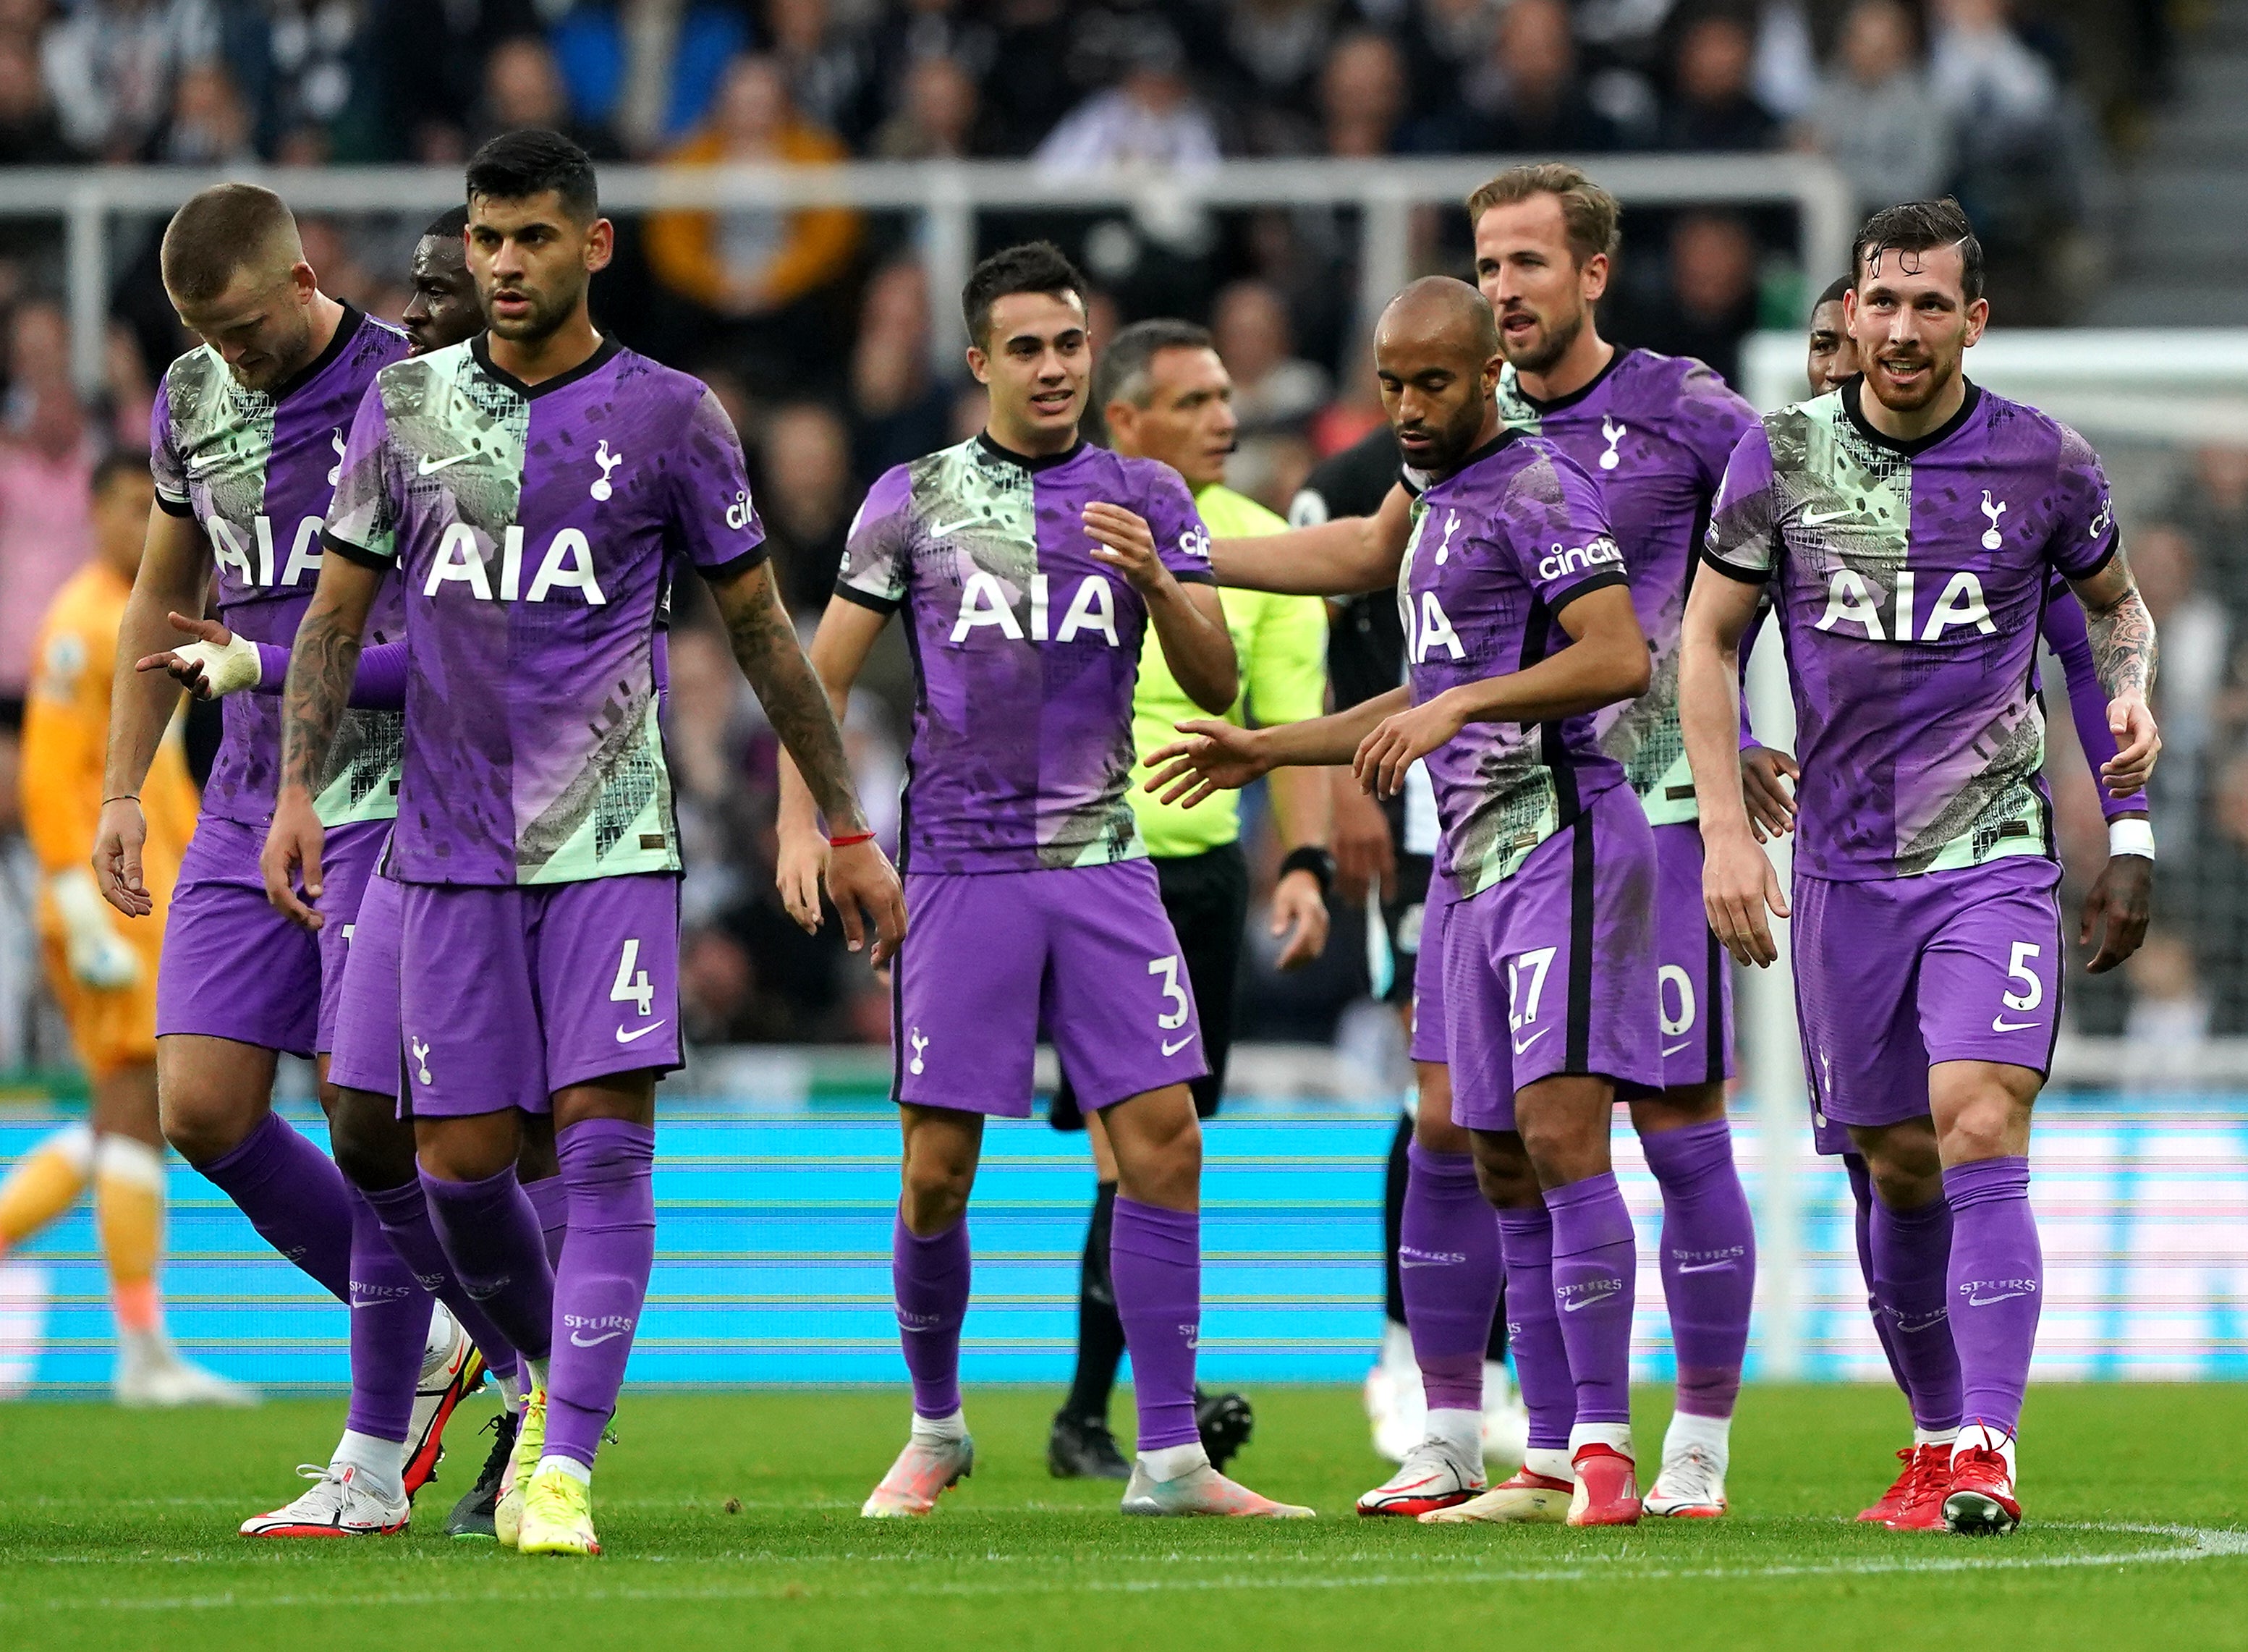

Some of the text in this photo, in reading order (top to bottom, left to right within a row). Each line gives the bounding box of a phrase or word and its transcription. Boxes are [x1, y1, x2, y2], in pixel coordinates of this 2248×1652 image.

[423, 522, 606, 605] AIA
[1539, 538, 1623, 580] cinch
[949, 572, 1119, 646] AIA
[1815, 569, 1997, 641] AIA
[610, 939, 654, 1016] 4
[1148, 954, 1189, 1029] 3
[1658, 964, 1696, 1036] 0
[2001, 941, 2043, 1011] 5
[349, 1280, 410, 1297] SPURS
[564, 1314, 632, 1331] SPURS
[1557, 1279, 1622, 1299] SPURS
[1959, 1279, 2036, 1295] SPURS
